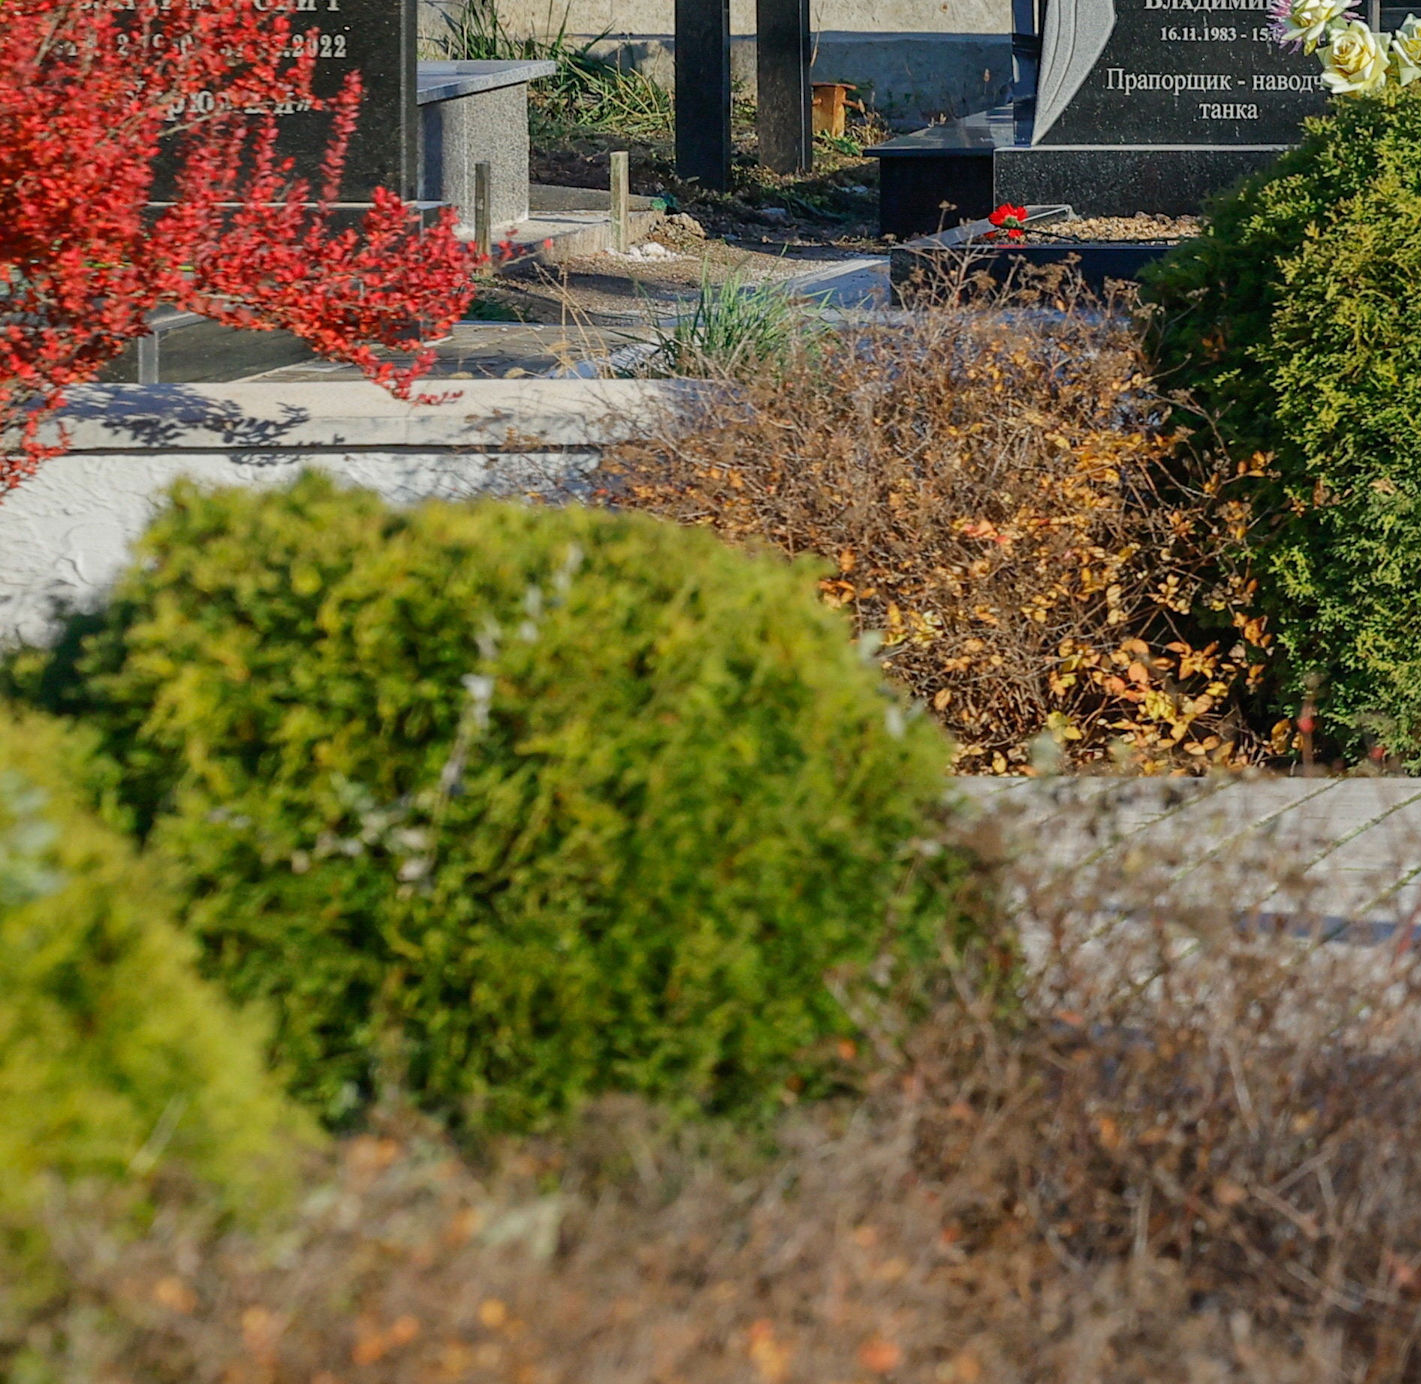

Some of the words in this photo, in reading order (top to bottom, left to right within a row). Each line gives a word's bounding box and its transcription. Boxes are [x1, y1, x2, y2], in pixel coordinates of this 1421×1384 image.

[1160, 27, 1237, 42] 16.11.1983
[1106, 69, 1232, 96] Прапорщик
[1199, 102, 1259, 120] танка
